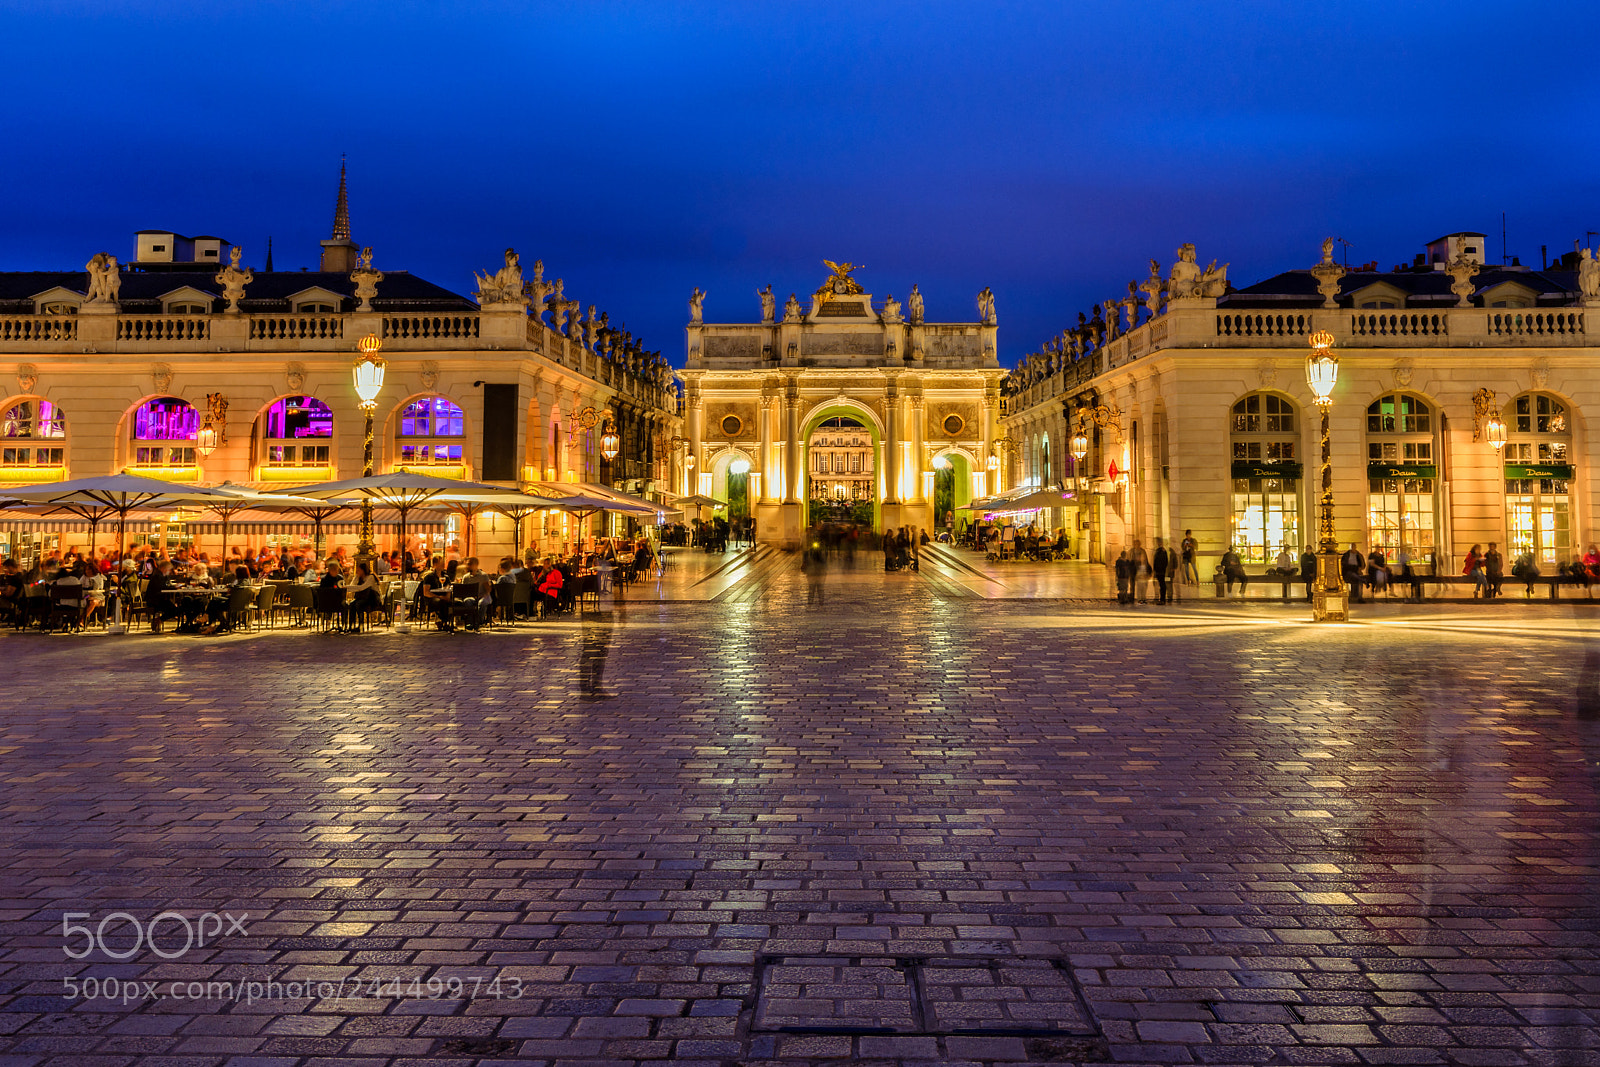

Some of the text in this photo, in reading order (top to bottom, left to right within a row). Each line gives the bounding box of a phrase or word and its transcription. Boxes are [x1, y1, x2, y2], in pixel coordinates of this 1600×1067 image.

[1253, 468, 1281, 476] Daum
[1389, 468, 1418, 476] Daum
[1525, 468, 1554, 476] Daum
